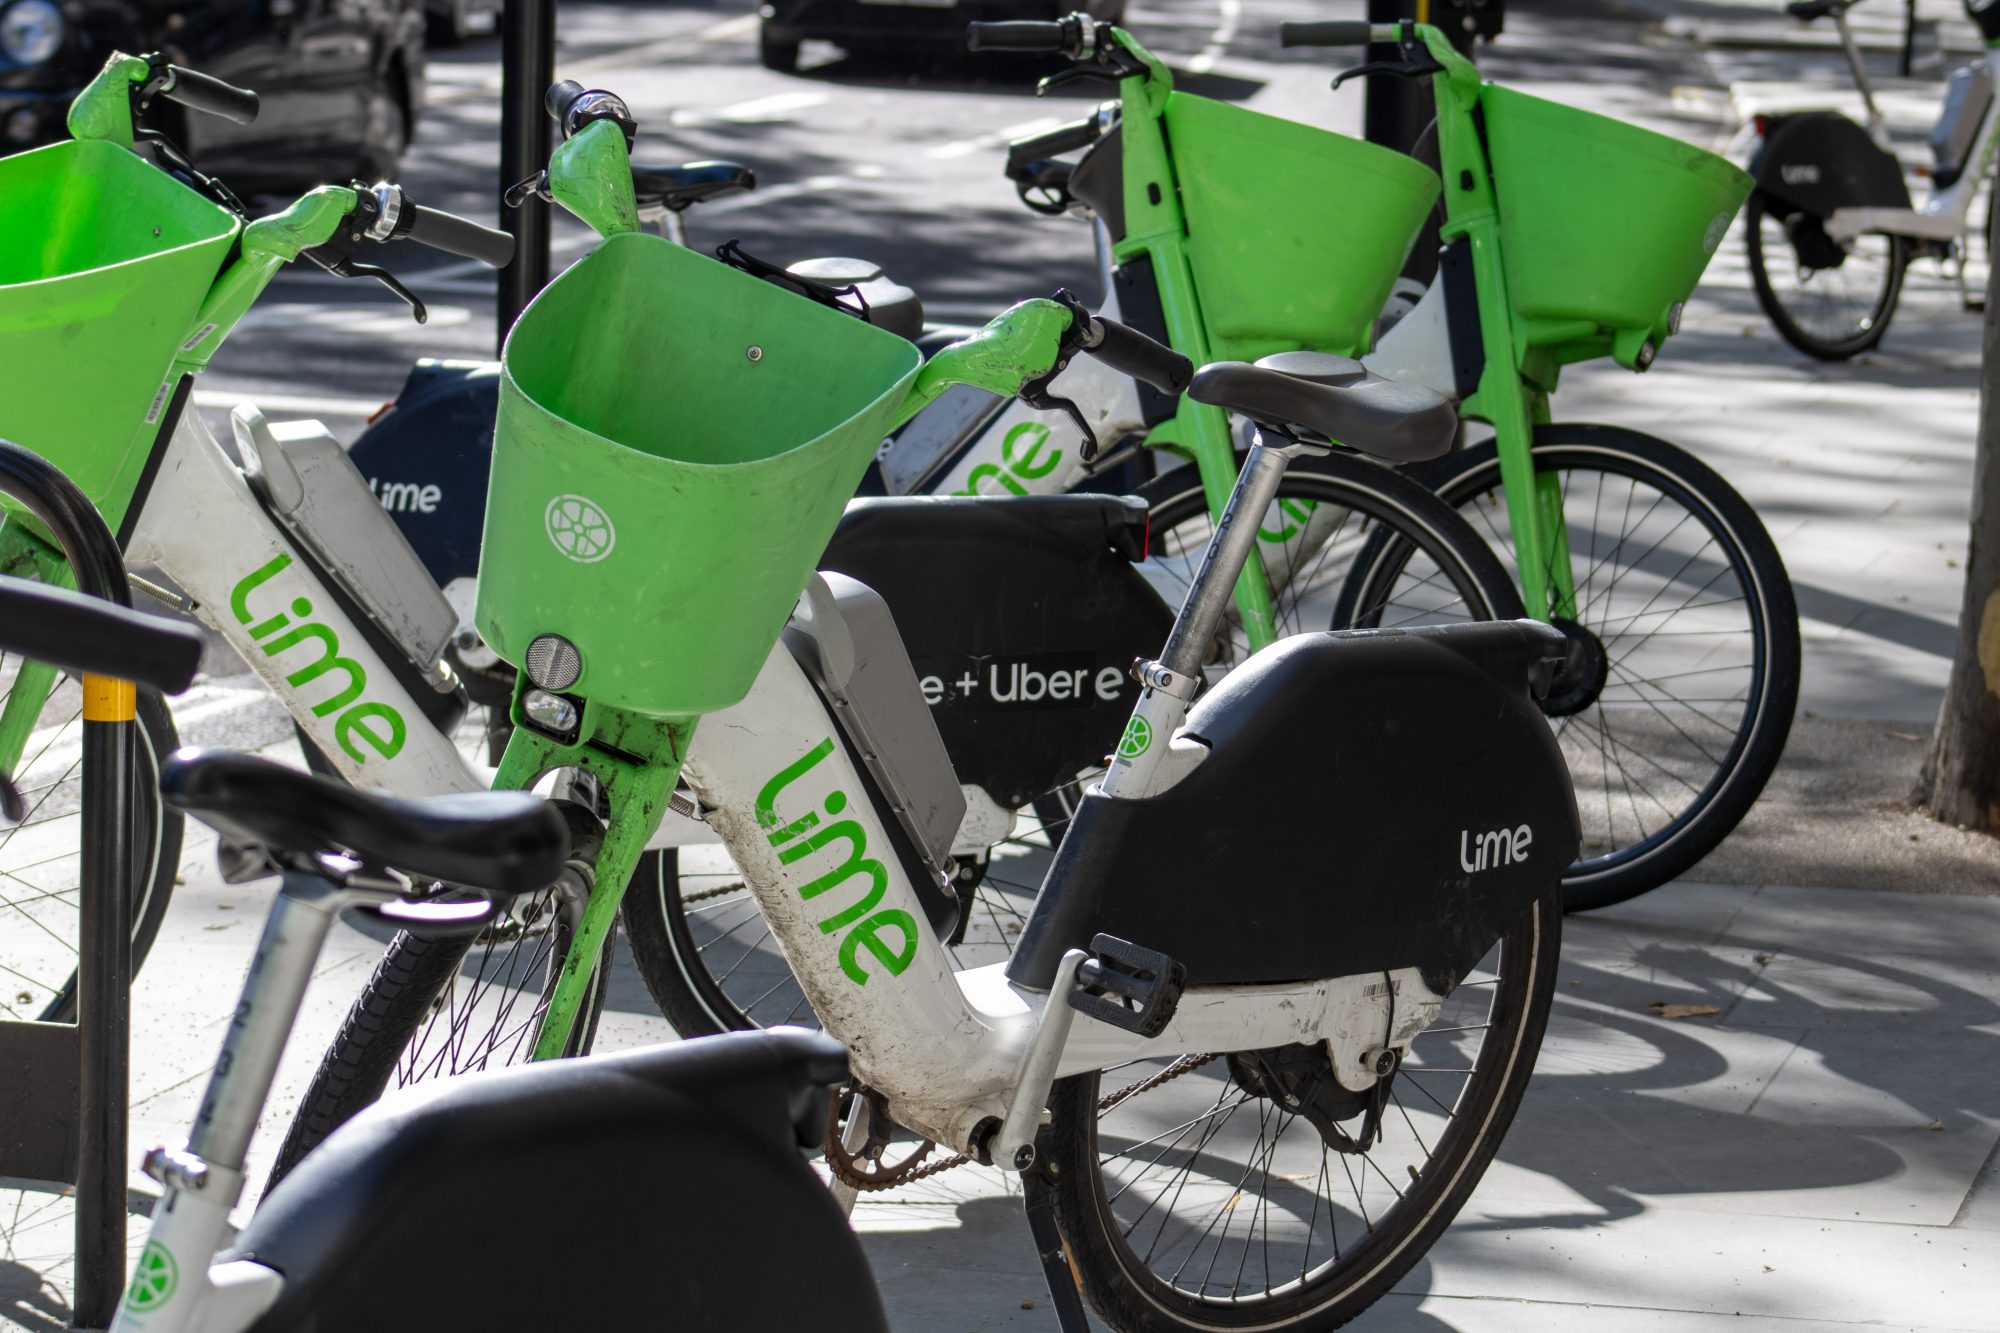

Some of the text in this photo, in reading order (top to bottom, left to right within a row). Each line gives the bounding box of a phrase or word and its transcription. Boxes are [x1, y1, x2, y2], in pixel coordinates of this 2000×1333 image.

[230, 551, 407, 765] Lime
[990, 662, 1088, 702] Uber
[754, 736, 919, 987] Lime
[1460, 823, 1532, 873] Lime
